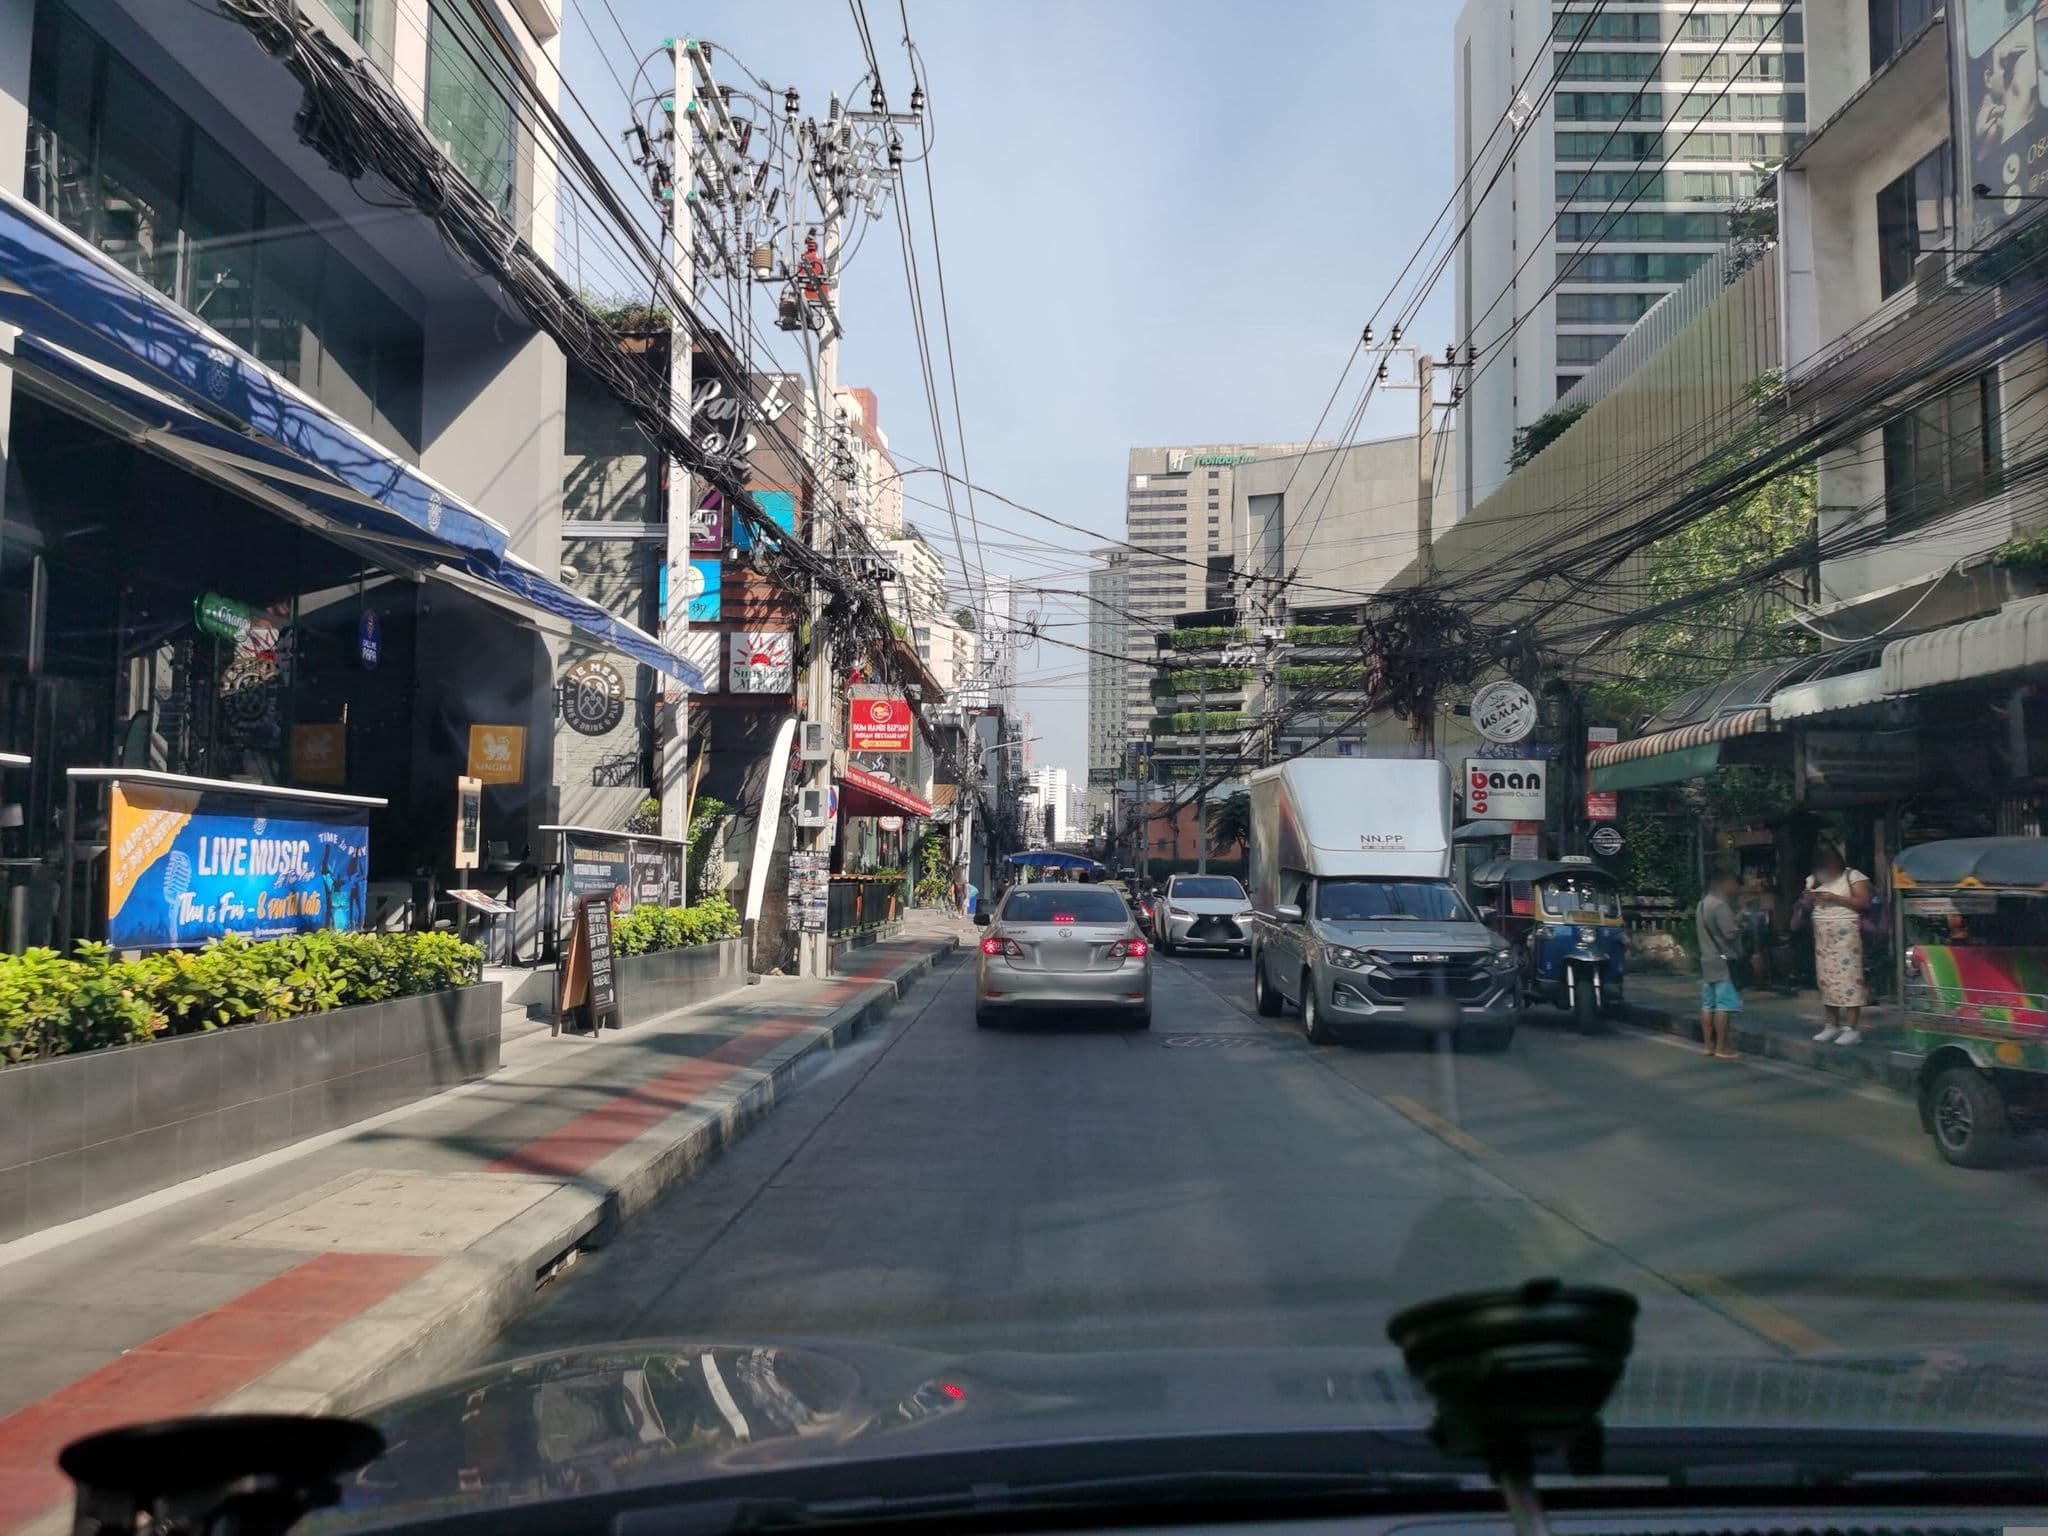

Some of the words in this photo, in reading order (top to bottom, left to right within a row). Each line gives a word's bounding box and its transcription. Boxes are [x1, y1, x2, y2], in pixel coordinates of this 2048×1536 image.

[566, 666, 586, 694] THE
[590, 663, 620, 695] MESH
[1480, 693, 1530, 730] USMAN
[198, 836, 248, 876] LIVE
[250, 838, 310, 877] MUSIC
[318, 831, 338, 844] TIME
[347, 845, 366, 858] PLAY
[178, 891, 204, 925] Thu
[219, 891, 245, 923] Fri
